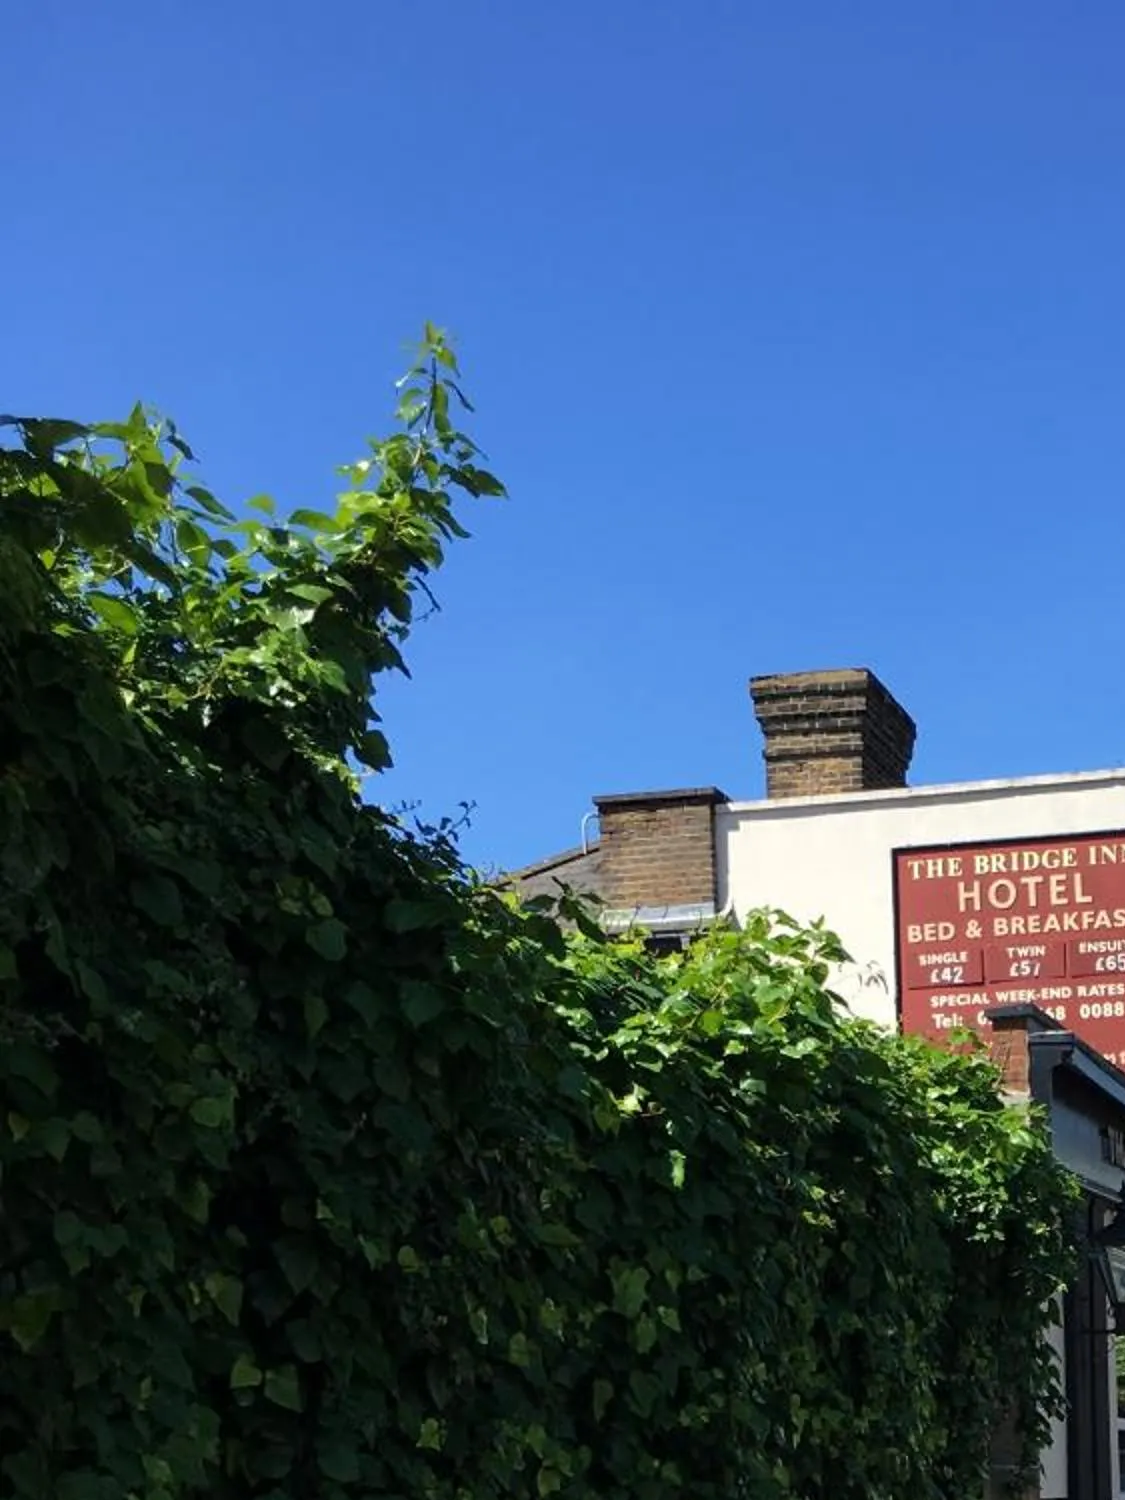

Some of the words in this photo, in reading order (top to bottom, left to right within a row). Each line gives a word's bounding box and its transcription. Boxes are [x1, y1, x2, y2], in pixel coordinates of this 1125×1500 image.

[908, 857, 963, 880] THE
[974, 848, 1077, 875] BRIDGE
[957, 873, 1093, 912] HOTEL
[907, 921, 955, 944] BED
[965, 919, 982, 939] &
[919, 950, 968, 967] SINGLE
[1006, 945, 1046, 959] TWIN
[930, 967, 964, 984] £42
[930, 993, 990, 1008] SPECIAL
[995, 986, 1072, 1004] WEEK-END
[1077, 983, 1125, 998] RATES
[932, 1012, 964, 1030] Tel:
[1079, 1001, 1125, 1019] 0088
